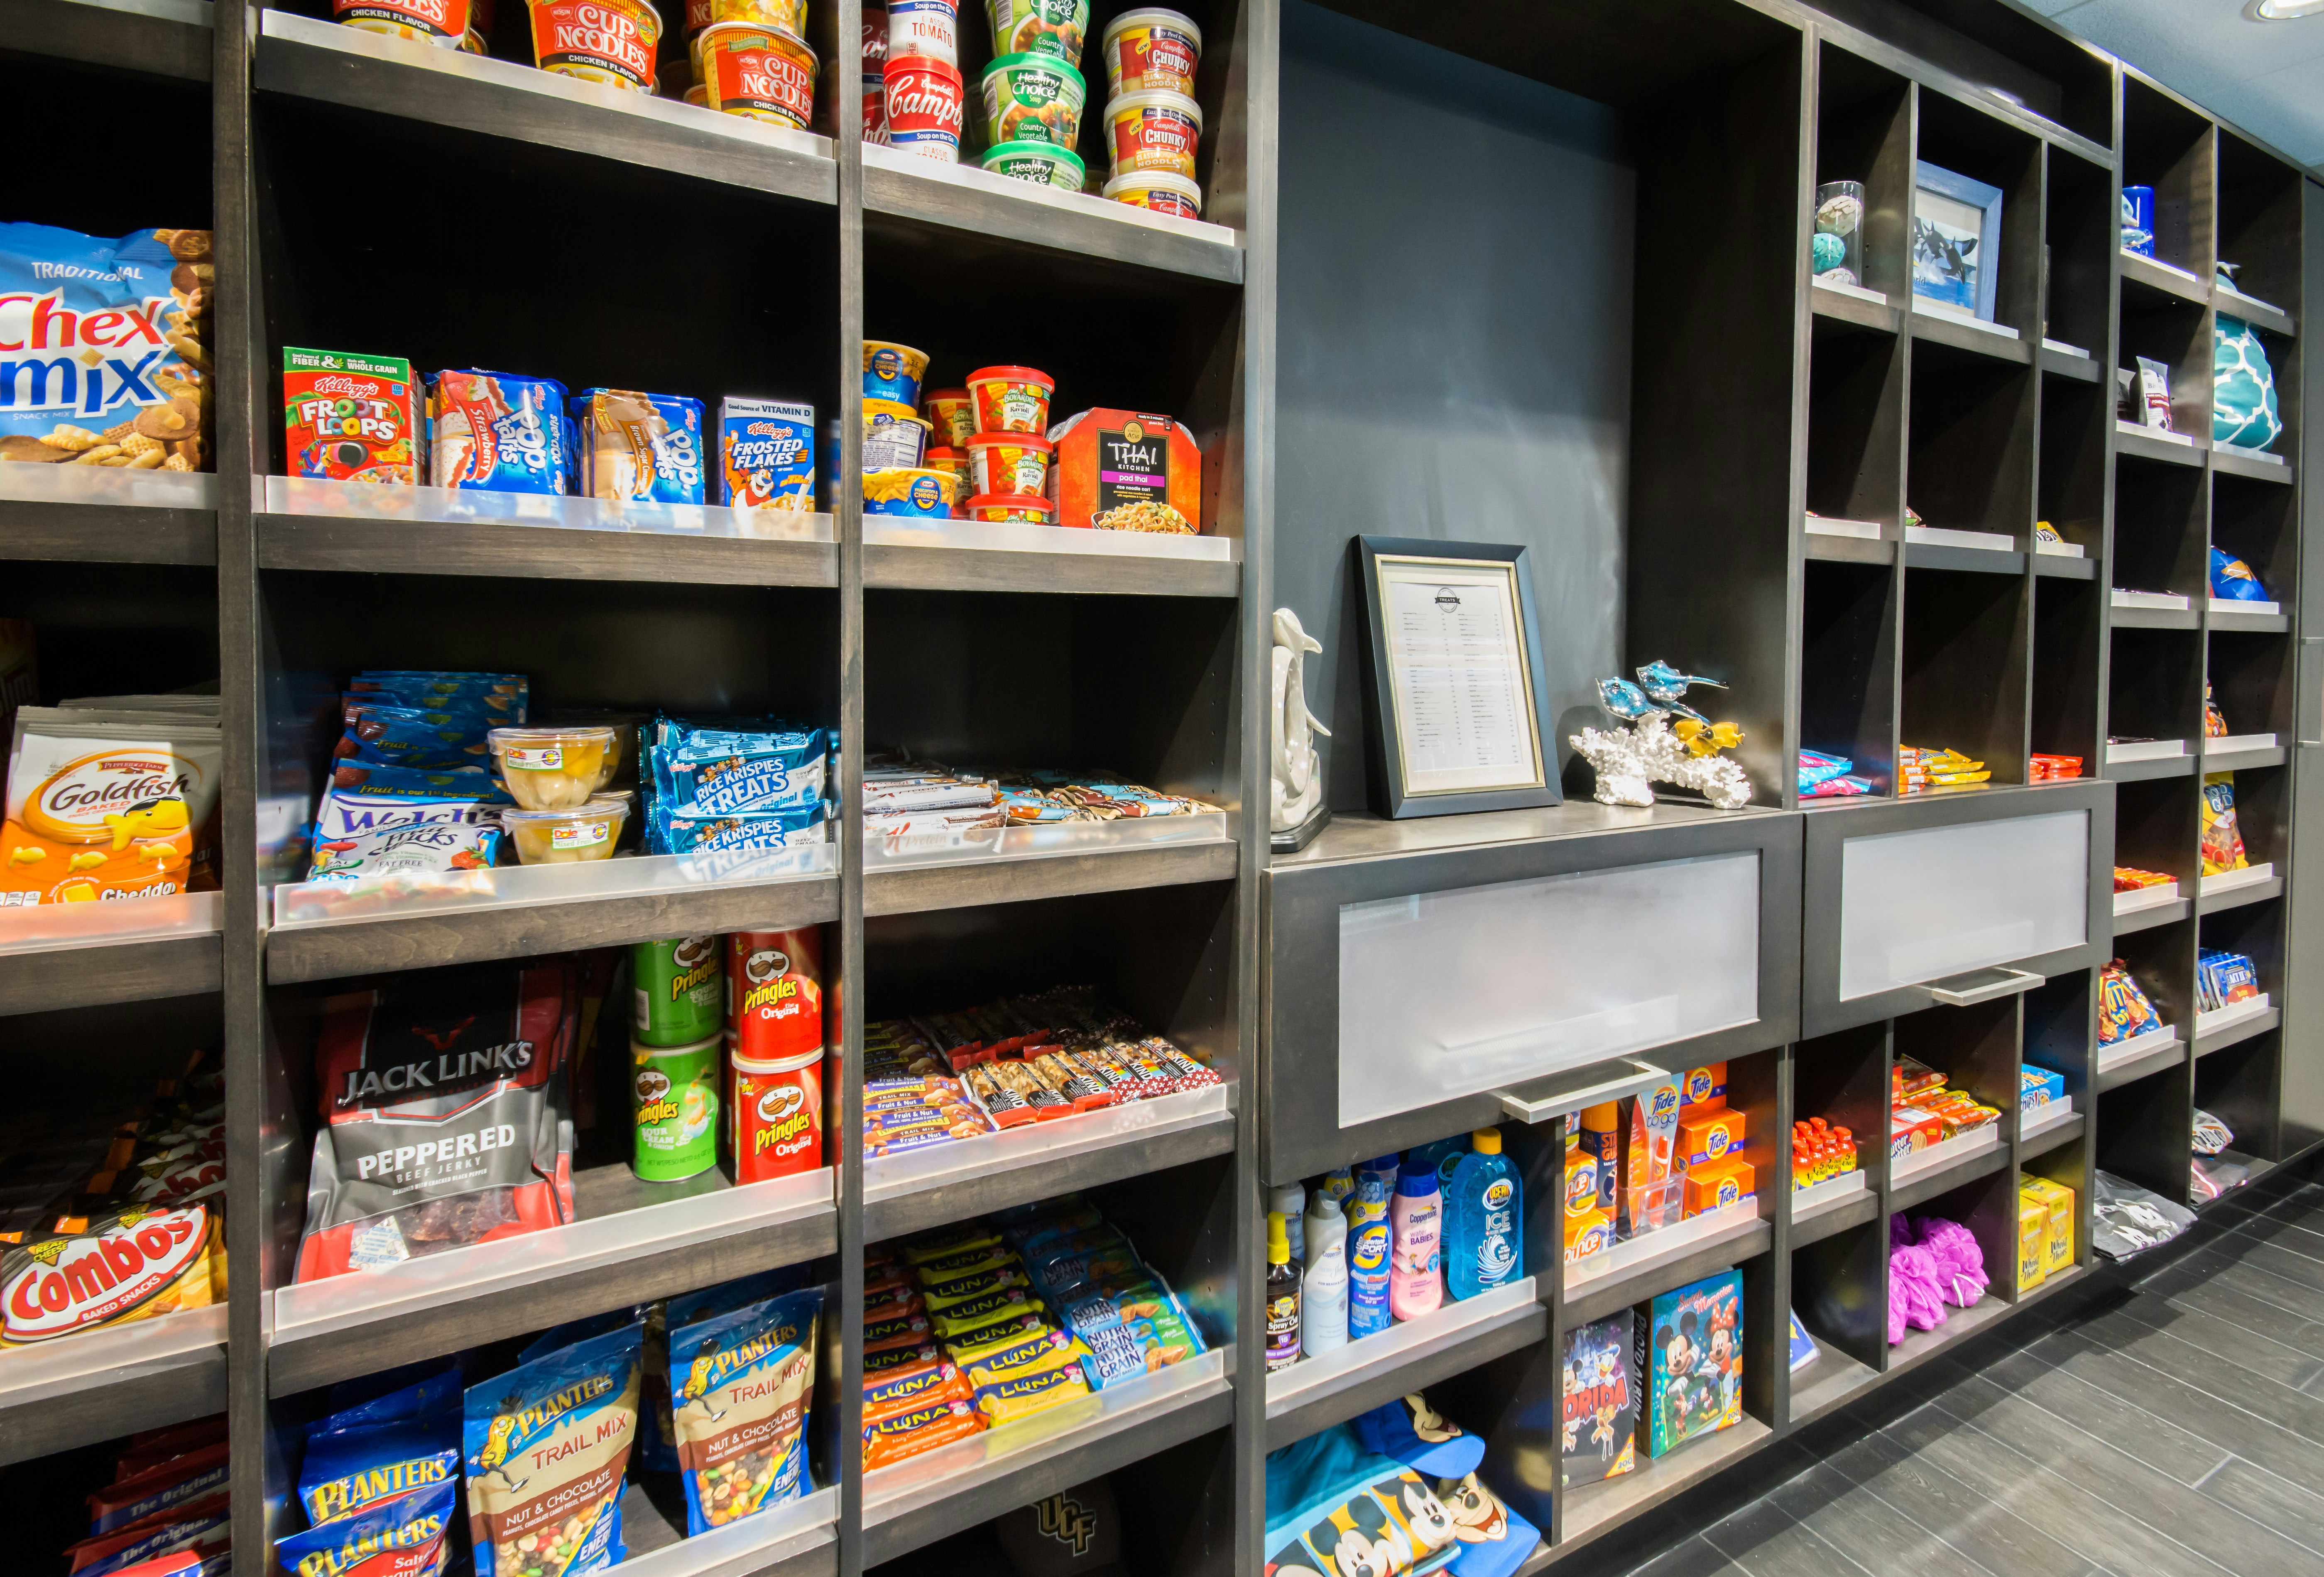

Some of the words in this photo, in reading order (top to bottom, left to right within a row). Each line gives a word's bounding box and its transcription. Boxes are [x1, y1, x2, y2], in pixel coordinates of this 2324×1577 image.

[351, 9, 390, 18] CHICKEN
[393, 12, 431, 32] FLAVOR
[579, 3, 634, 39] CUP
[1049, 12, 1060, 22] Soup
[912, 22, 952, 48] TOMATO
[1038, 37, 1064, 52] Country
[556, 25, 647, 74] NOODLES
[1138, 42, 1150, 52] NEW!
[569, 55, 607, 68] CHICKEN
[610, 63, 637, 82] FLAVOR
[1152, 49, 1190, 75] CHUNKY
[764, 57, 807, 90] CUP
[1017, 72, 1059, 89] Healthy
[1012, 82, 1056, 99] Choice
[1029, 95, 1041, 104] Soup
[754, 101, 787, 115] CHICKEN
[789, 111, 807, 129] FLAVOR
[1020, 123, 1047, 134] Country
[1131, 123, 1142, 133] NEW!
[1153, 120, 1180, 132] Campbell's
[1018, 132, 1048, 142] Vegetable
[1145, 129, 1186, 150] CHUNKY
[1009, 159, 1051, 175] Healthy
[0, 295, 163, 352] Chex
[292, 358, 320, 367] FIBER
[347, 362, 374, 372] WHOLE
[375, 364, 397, 374] GRAIN
[0, 350, 162, 413] mix
[315, 377, 378, 396] Kellogg's
[882, 390, 900, 401] easy
[1004, 394, 1036, 406] BOYARDEE
[13, 412, 48, 421] SNACK
[761, 405, 801, 416] VITAMIN
[804, 408, 811, 417] D
[318, 417, 397, 440] LOOPS
[747, 422, 793, 439] Kellogg's
[470, 408, 490, 473] Strawberry
[629, 425, 644, 446] Brown
[639, 447, 648, 466] Sugar
[733, 440, 803, 457] FROSTED
[735, 452, 795, 469] FLAKES
[1017, 460, 1043, 472] BOYARDEE
[1118, 464, 1150, 472] KITCHEN
[359, 784, 393, 795] Fruit
[697, 776, 723, 803] RICE
[724, 758, 784, 786] KRISPIES
[49, 774, 190, 811] Goldfish
[701, 772, 789, 815] TREATS
[76, 801, 131, 813] BAKED
[91, 806, 127, 815] CRACKERS
[554, 829, 577, 840] Dole
[575, 838, 592, 847] Fruit
[721, 819, 782, 846] KRISPIES
[744, 978, 797, 1015] Pringles
[762, 1003, 798, 1020] Original
[337, 1061, 434, 1106] JACK
[438, 1041, 535, 1081] LINK'S
[1130, 1061, 1153, 1080] KIND
[1173, 1055, 1196, 1073] KIND
[1080, 1074, 1102, 1095] KIND
[1099, 1066, 1122, 1084] KIND
[1691, 1075, 1710, 1097] Tide
[1005, 1088, 1026, 1108] KIND
[1653, 1091, 1676, 1113] Tide
[1646, 1114, 1659, 1127] to
[1660, 1112, 1677, 1130] go
[755, 1112, 810, 1156] Pringles
[900, 1135, 918, 1143] Fruit
[1708, 1131, 1728, 1154] Tide
[357, 1124, 516, 1180] PEPPERED
[776, 1135, 811, 1156] Original
[397, 1167, 431, 1183] BEEF
[438, 1156, 482, 1175] JERKY
[468, 1168, 487, 1178] PEPPER
[1489, 1185, 1509, 1199] OCEAN
[1719, 1184, 1737, 1208] Tide
[1410, 1209, 1437, 1224] Coppertone
[1486, 1210, 1511, 1231] ICE
[2050, 1209, 2068, 1223] ORIGINAL
[1411, 1232, 1433, 1245] BABIES
[2023, 1227, 2042, 1243] ORIGINAL
[2050, 1236, 2067, 1254] Wheat
[1356, 1242, 1387, 1253] SPORT
[2050, 1249, 2067, 1264] Thins
[11, 1220, 193, 1320] Combos
[2022, 1254, 2040, 1272] Wheat
[2021, 1266, 2039, 1283] Thins
[82, 1301, 118, 1321] BAKED
[120, 1275, 161, 1306] SNACKS
[950, 1296, 1008, 1318] LUNA
[1678, 1288, 1703, 1312] Sweet
[1694, 1283, 1734, 1314] Memories
[1268, 1322, 1288, 1331] Spray
[1289, 1316, 1298, 1326] Oil
[961, 1323, 1023, 1347] LUNA
[1086, 1324, 1129, 1346] NUTRI
[1092, 1331, 1134, 1355] GRAIN
[715, 1323, 798, 1375] PLANTERS
[989, 1340, 1053, 1370] LUNA
[1095, 1342, 1136, 1369] NUTRI
[1100, 1350, 1142, 1379] GRAIN
[729, 1378, 780, 1405] TRAIL
[781, 1355, 808, 1384] MIX
[872, 1373, 942, 1402] LUNA
[1000, 1371, 1067, 1398] LUNA
[517, 1373, 615, 1438] PLANTERS
[878, 1406, 950, 1433] LUNA
[531, 1432, 593, 1471] TRAIL
[596, 1411, 628, 1445] MIX
[709, 1437, 730, 1455] NUT
[732, 1433, 740, 1443] &
[742, 1407, 798, 1440] CHOCOLATE
[313, 1457, 447, 1526] PLANTERS
[506, 1507, 531, 1527] NUT
[534, 1502, 544, 1514] &
[547, 1468, 611, 1509] CHOCOLATE
[130, 1498, 157, 1517] The
[1041, 1494, 1095, 1551] UCF
